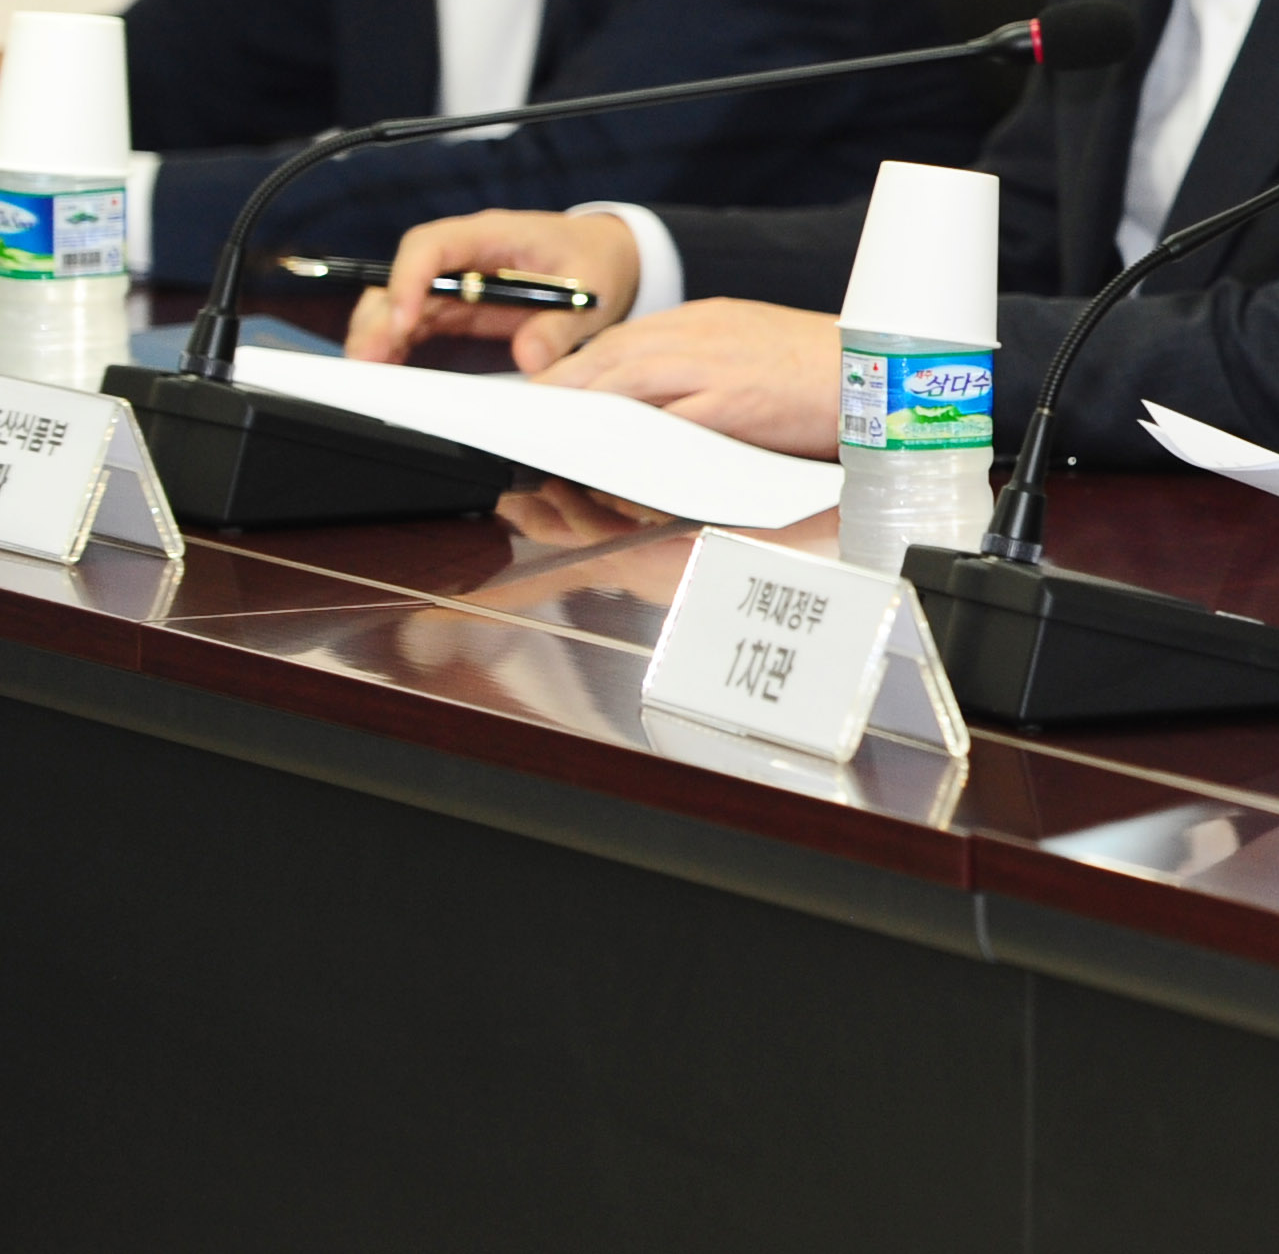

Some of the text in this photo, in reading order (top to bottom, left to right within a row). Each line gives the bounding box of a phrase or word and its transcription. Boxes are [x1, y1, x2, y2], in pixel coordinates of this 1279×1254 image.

[926, 370, 991, 398] 삼다수
[0, 410, 69, 456] 산식품부
[737, 576, 830, 634] 기획재정부
[724, 638, 798, 704] 1차관
